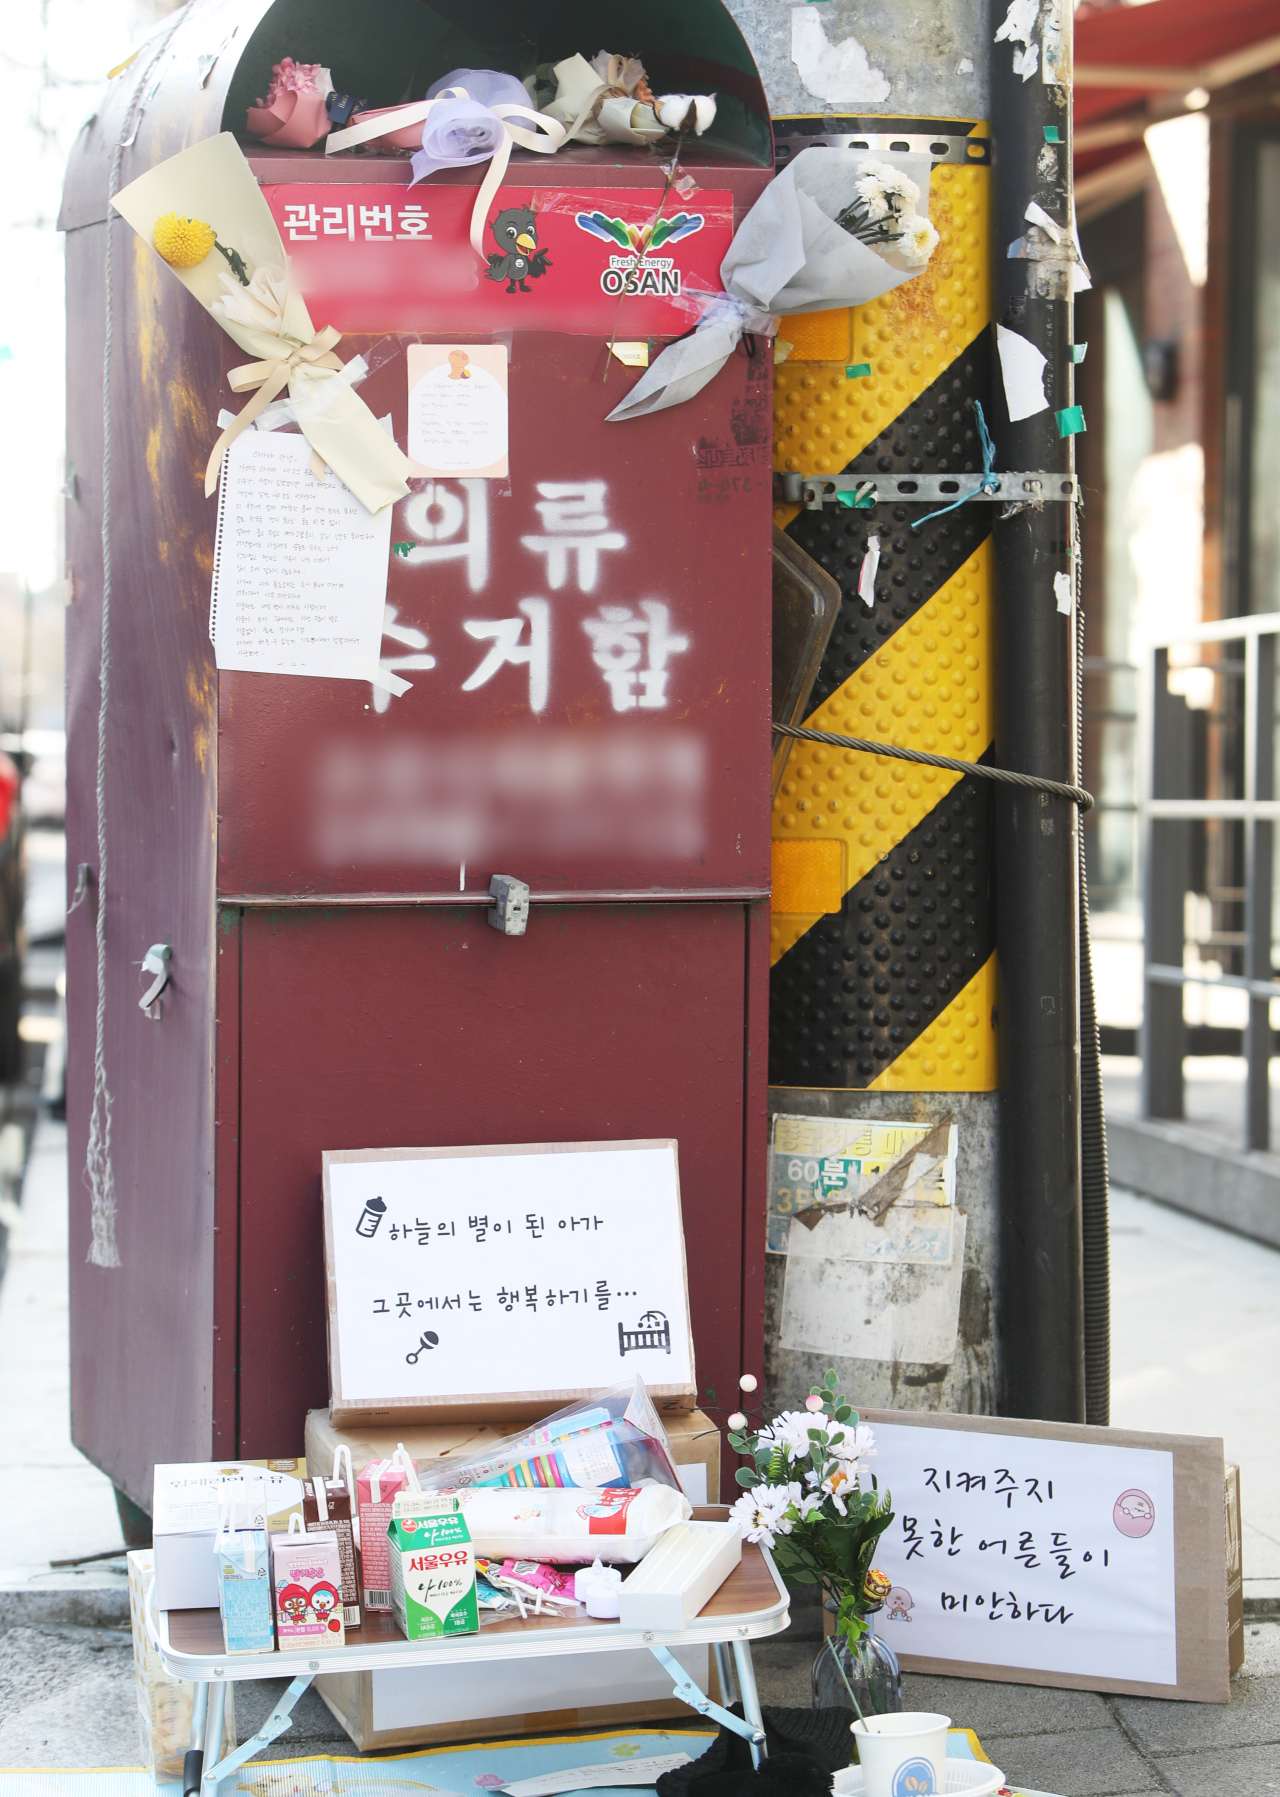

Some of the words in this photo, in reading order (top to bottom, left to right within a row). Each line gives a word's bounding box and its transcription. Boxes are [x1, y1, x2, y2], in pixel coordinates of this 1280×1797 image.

[284, 203, 433, 242] 관리번호
[611, 257, 637, 267] Fresh
[639, 257, 673, 269] Energy
[602, 269, 681, 295] OSAN
[404, 479, 628, 593] 의류
[388, 1217, 456, 1246] 하늘의
[468, 1215, 512, 1243] 별이
[525, 1213, 546, 1239] 된
[558, 1215, 604, 1232] 아가
[372, 1289, 483, 1319] 그곳에서는
[923, 1467, 1055, 1509] 지켜주지
[417, 1517, 460, 1530] 서울우유
[408, 1550, 469, 1572] 서울우유
[902, 1514, 965, 1560] 못한
[978, 1531, 1110, 1580] 어른들이
[940, 1590, 1075, 1625] 미안하다
